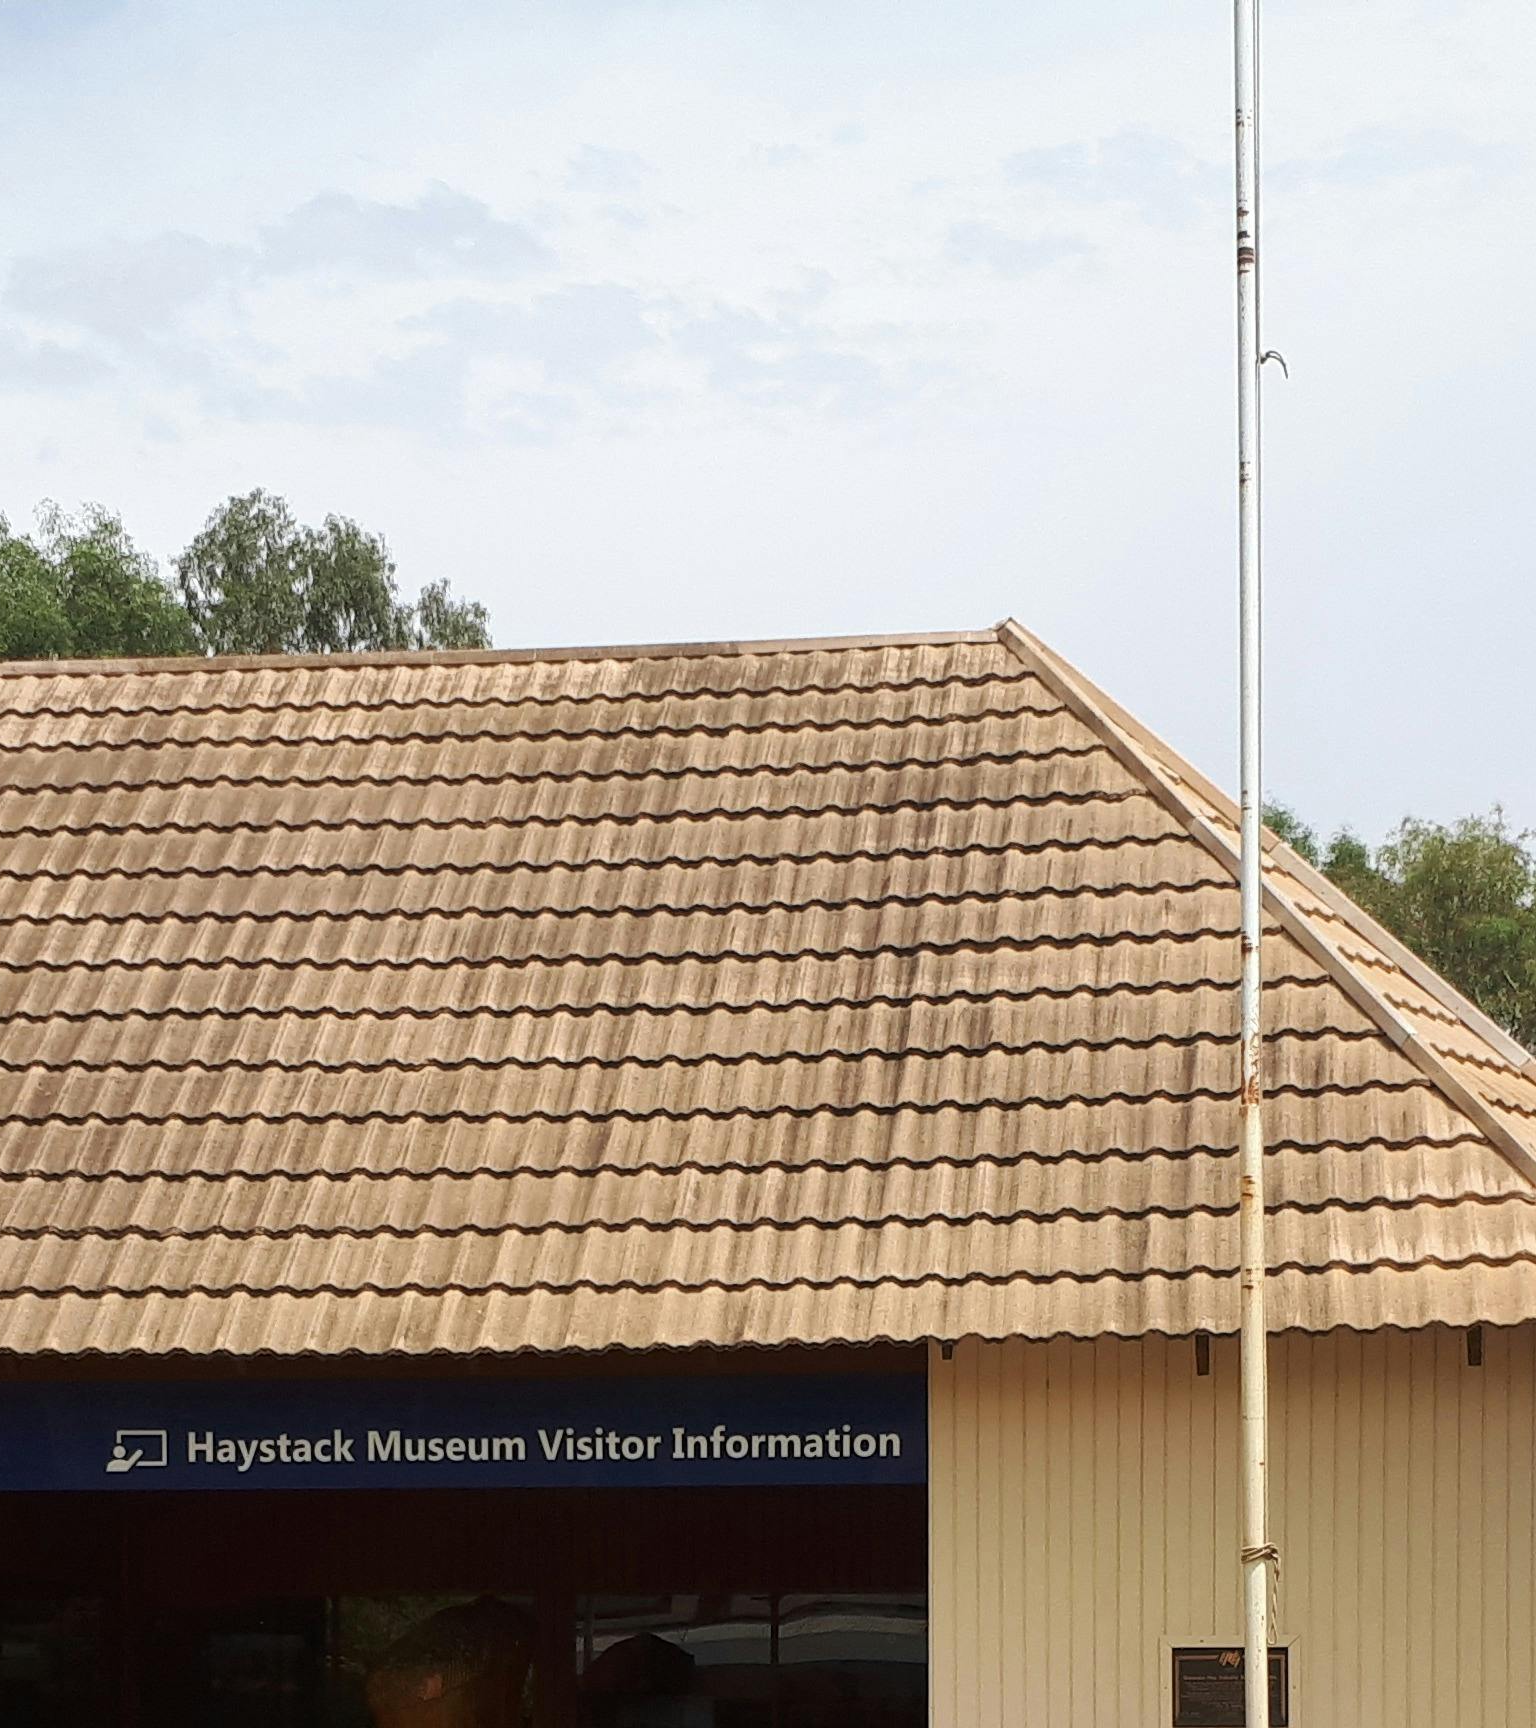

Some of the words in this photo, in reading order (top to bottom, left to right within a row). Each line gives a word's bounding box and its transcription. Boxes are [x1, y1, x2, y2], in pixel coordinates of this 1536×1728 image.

[189, 1430, 354, 1471] Haystack
[368, 1431, 525, 1461] Museum
[538, 1428, 661, 1460] Visitor
[673, 1425, 900, 1458] Information
